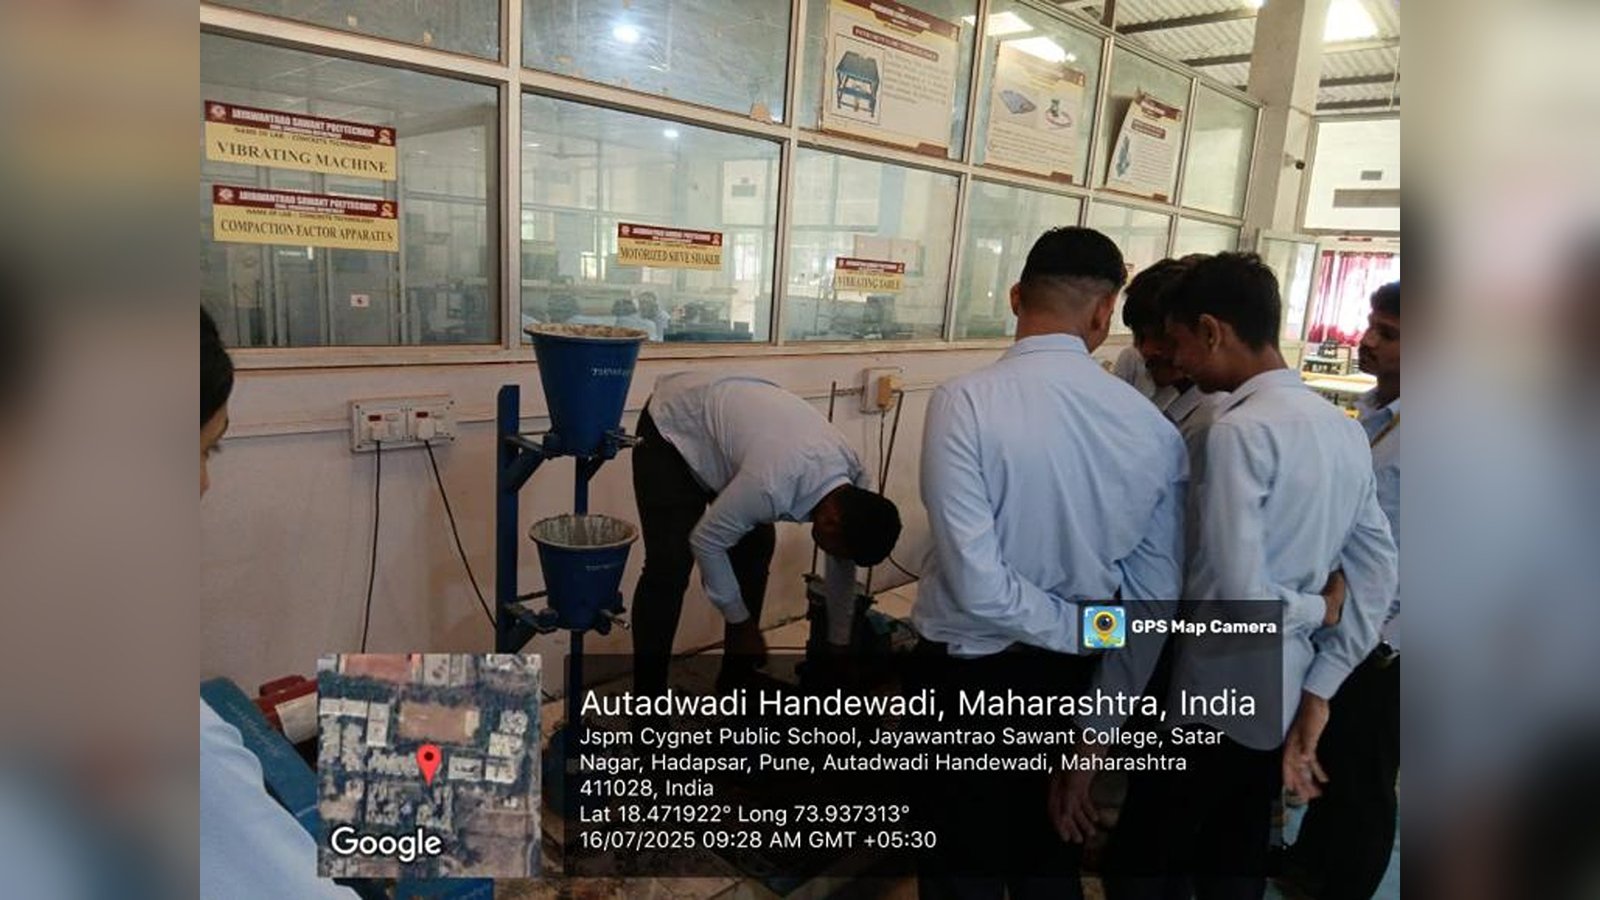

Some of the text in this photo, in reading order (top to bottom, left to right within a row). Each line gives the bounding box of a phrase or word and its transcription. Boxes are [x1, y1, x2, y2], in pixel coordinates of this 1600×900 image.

[216, 140, 388, 174] VIBRATING MACHINE
[221, 219, 295, 236] COMPACTION
[297, 223, 337, 239] FACTOR
